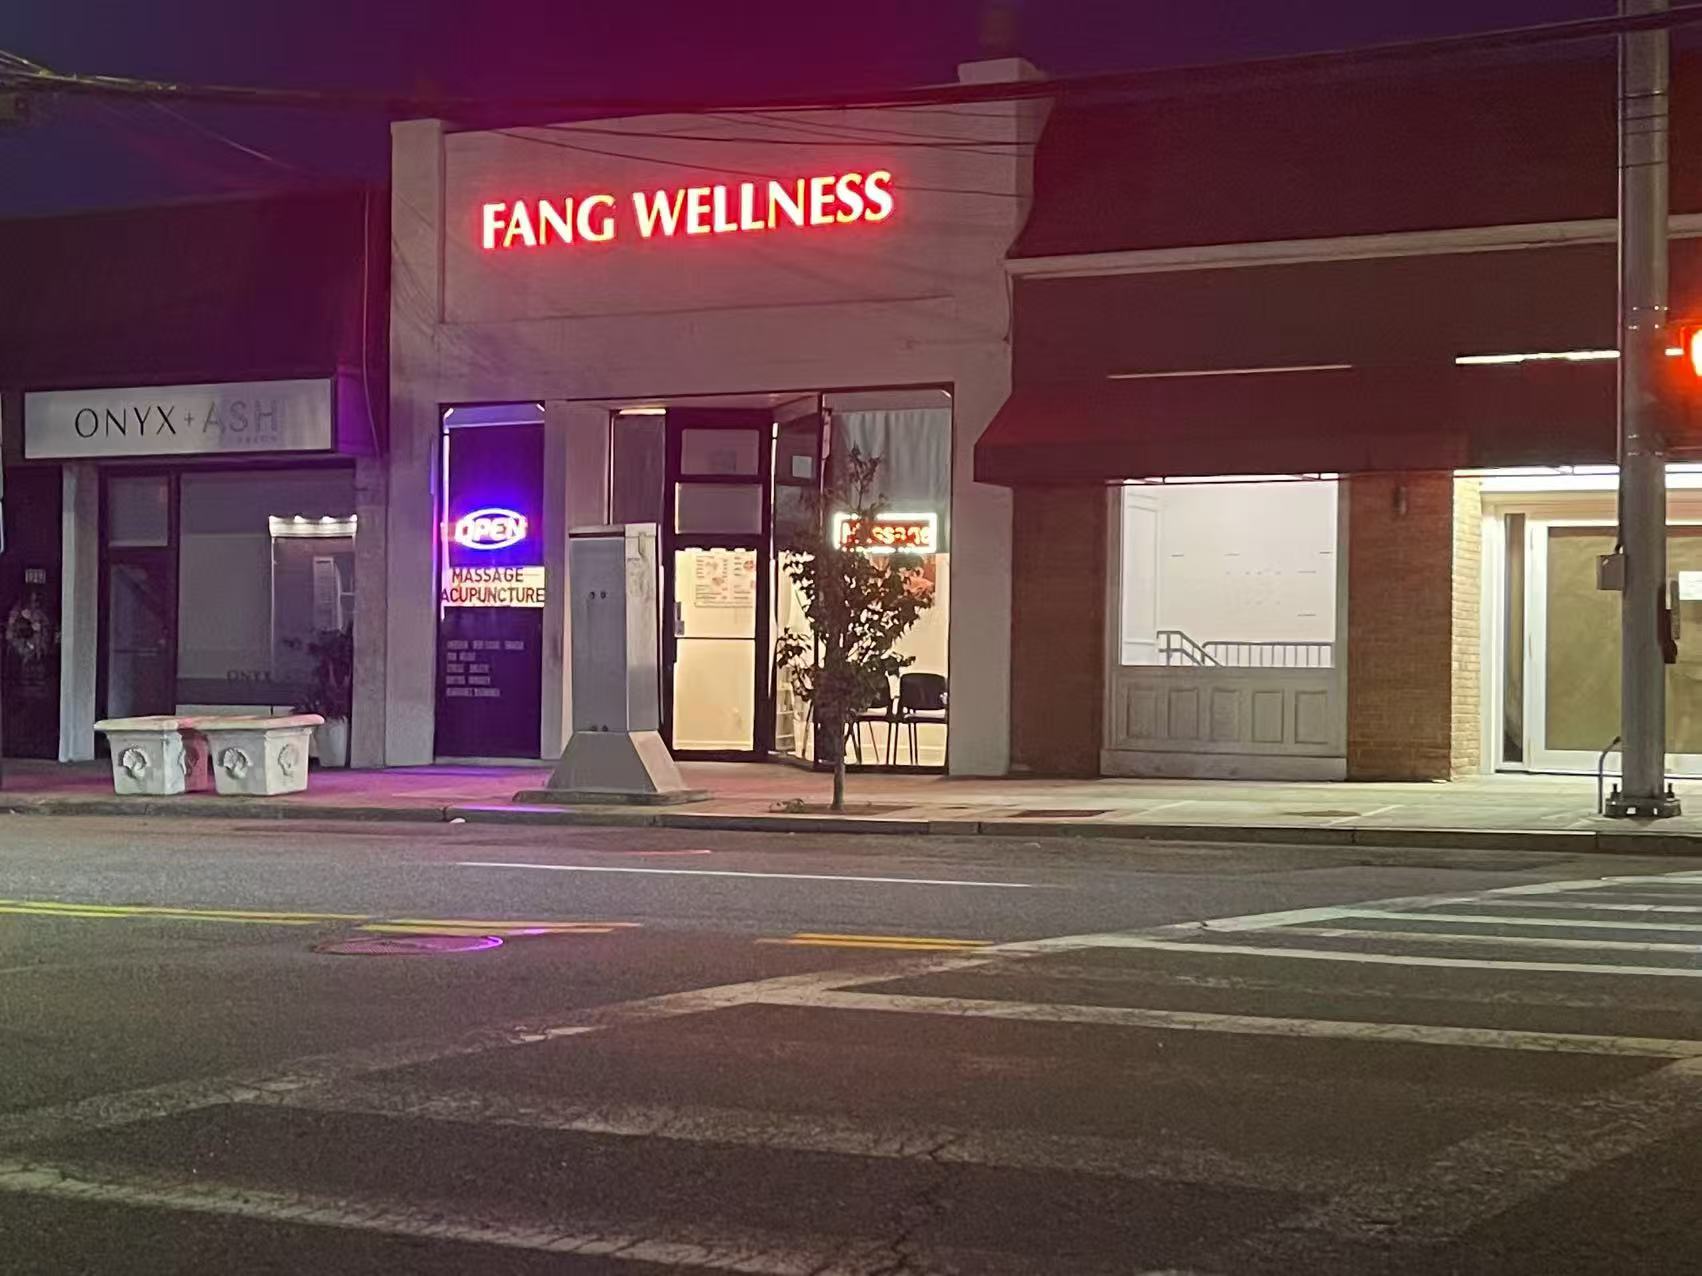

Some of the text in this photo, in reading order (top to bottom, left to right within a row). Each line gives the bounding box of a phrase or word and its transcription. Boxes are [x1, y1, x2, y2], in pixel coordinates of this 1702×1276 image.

[482, 170, 893, 249] FANG WELLNESS
[74, 405, 177, 438] ONYX
[202, 400, 278, 434] ASH
[455, 516, 528, 542] OPEN
[451, 567, 524, 583] MASSAGE
[440, 586, 545, 603] ACUPUNCTURE
